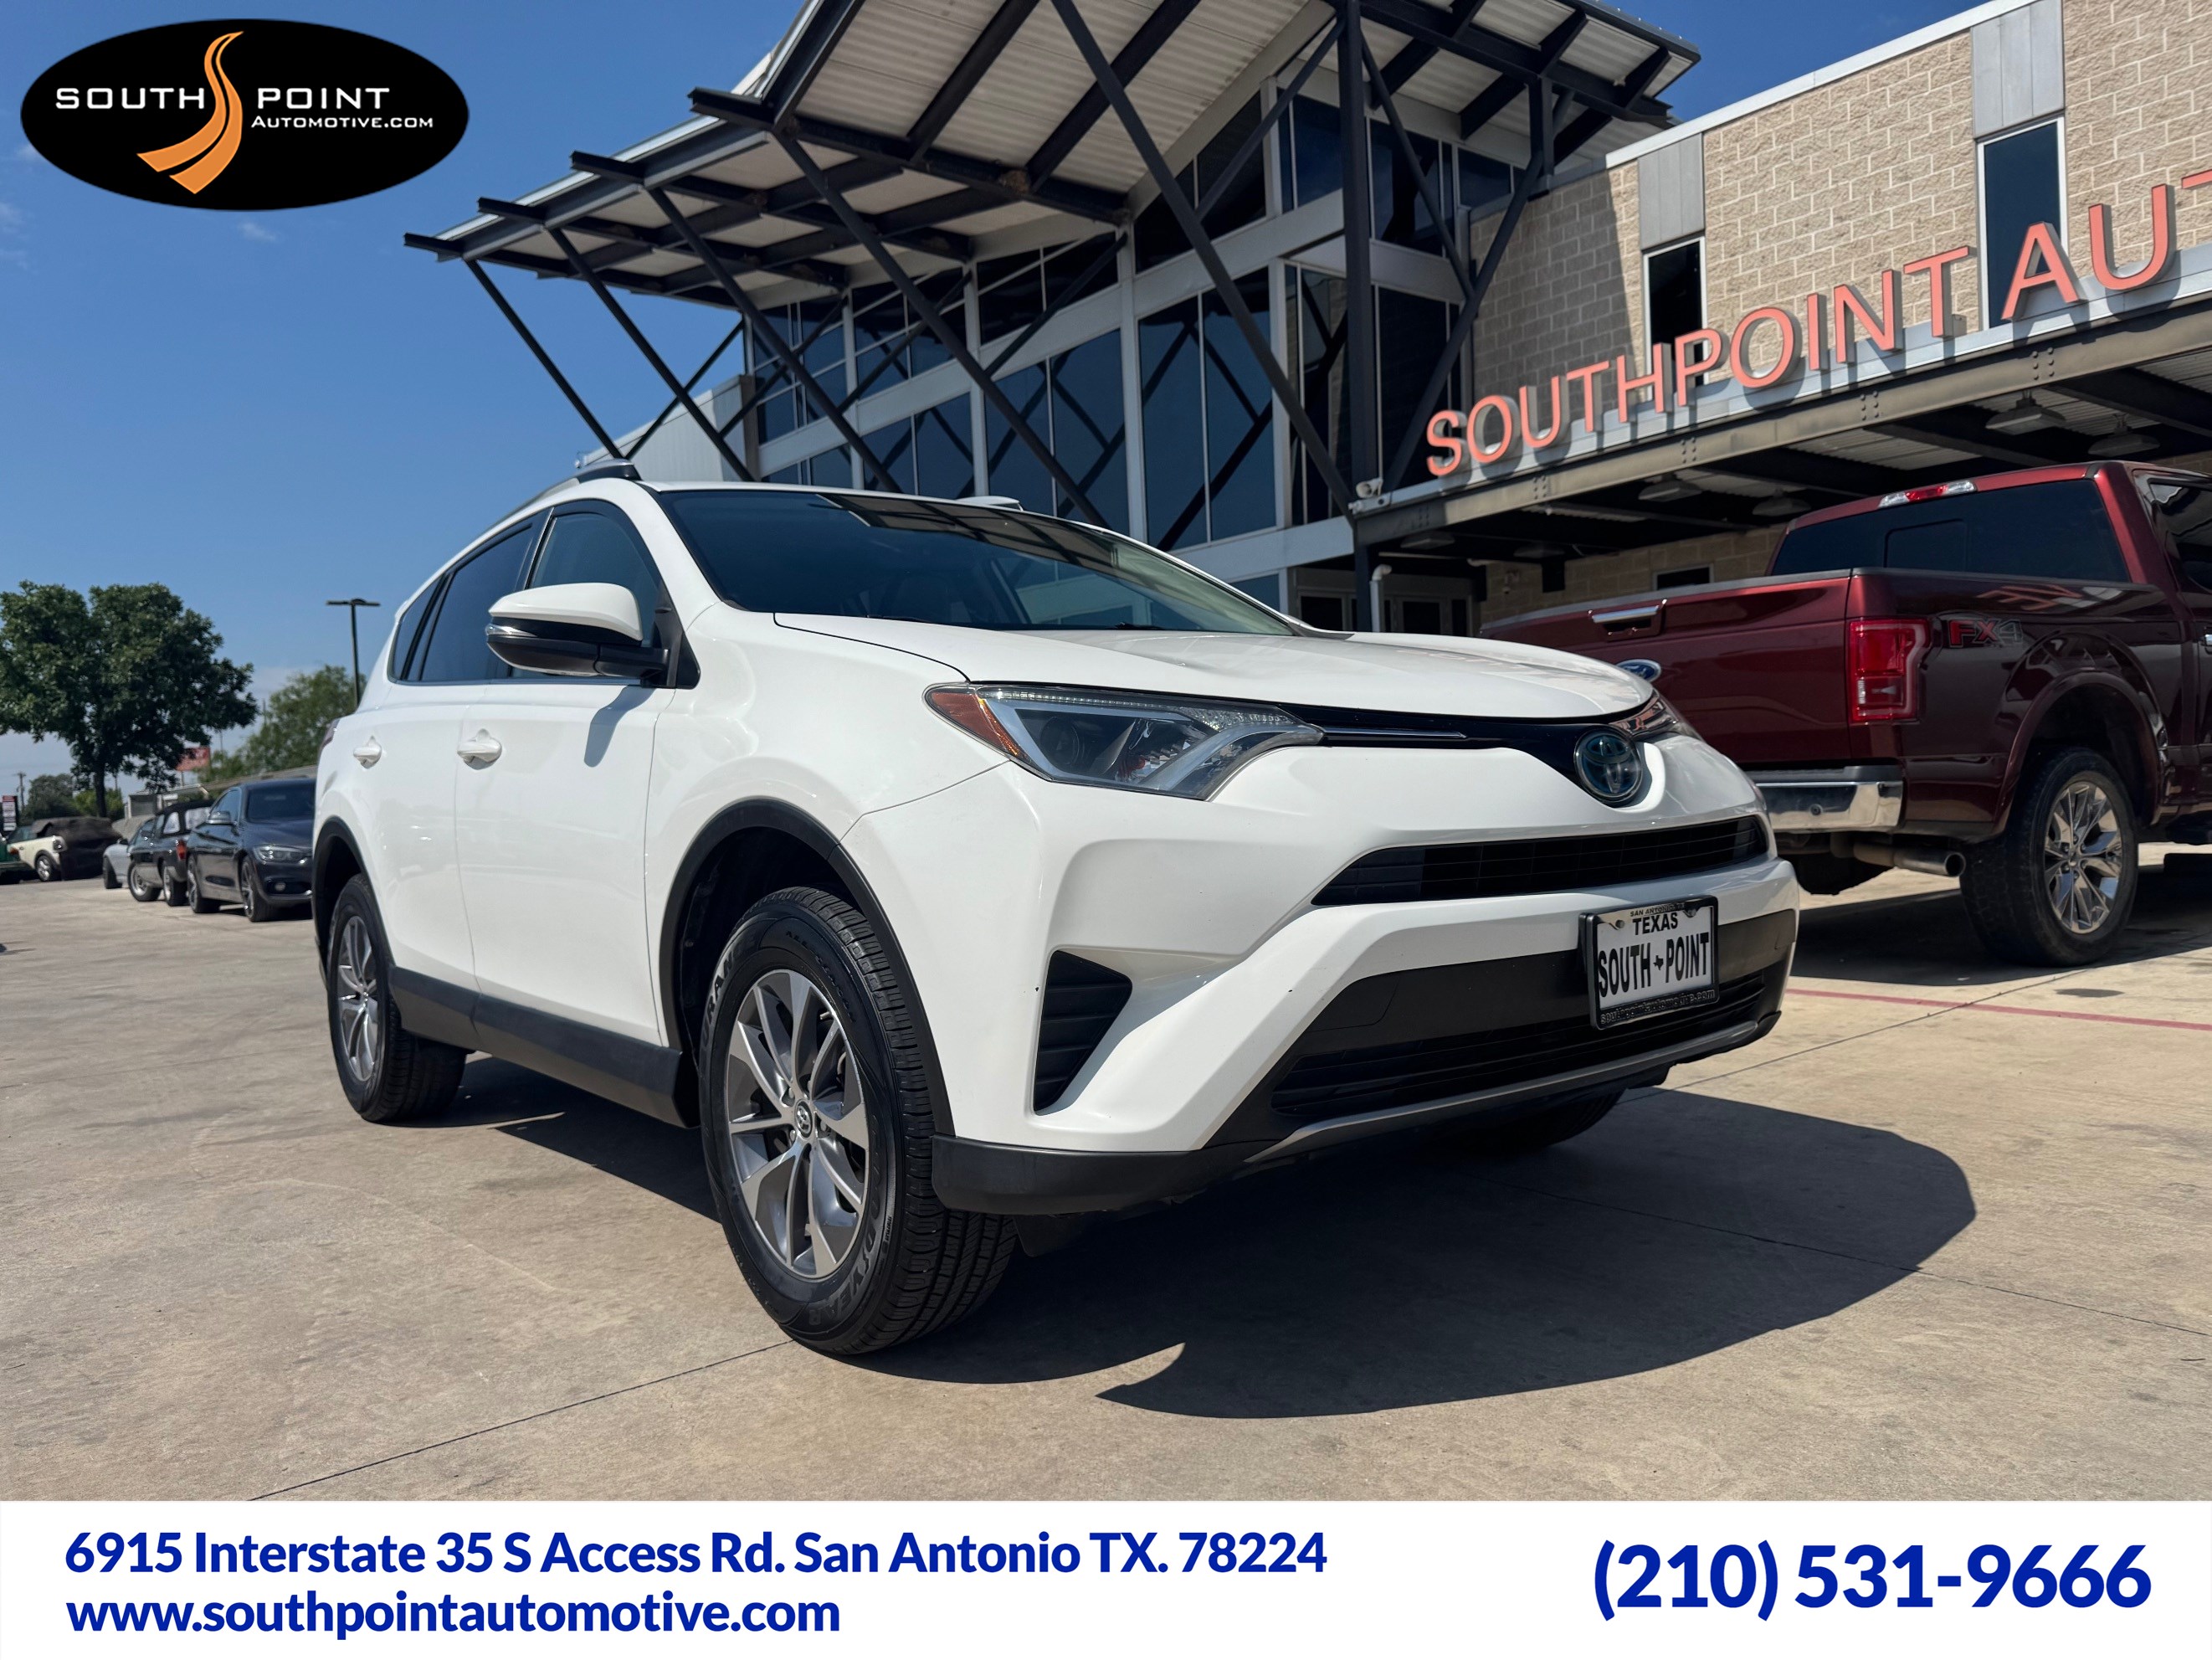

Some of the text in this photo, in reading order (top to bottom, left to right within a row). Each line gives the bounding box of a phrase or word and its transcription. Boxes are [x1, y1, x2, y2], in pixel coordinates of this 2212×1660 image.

[1426, 169, 2212, 477] SOUTHPOINT AU
[1948, 619, 2024, 648] FX4
[1632, 912, 1679, 935] TEXAS
[1599, 932, 1709, 997] SOUTH POINT
